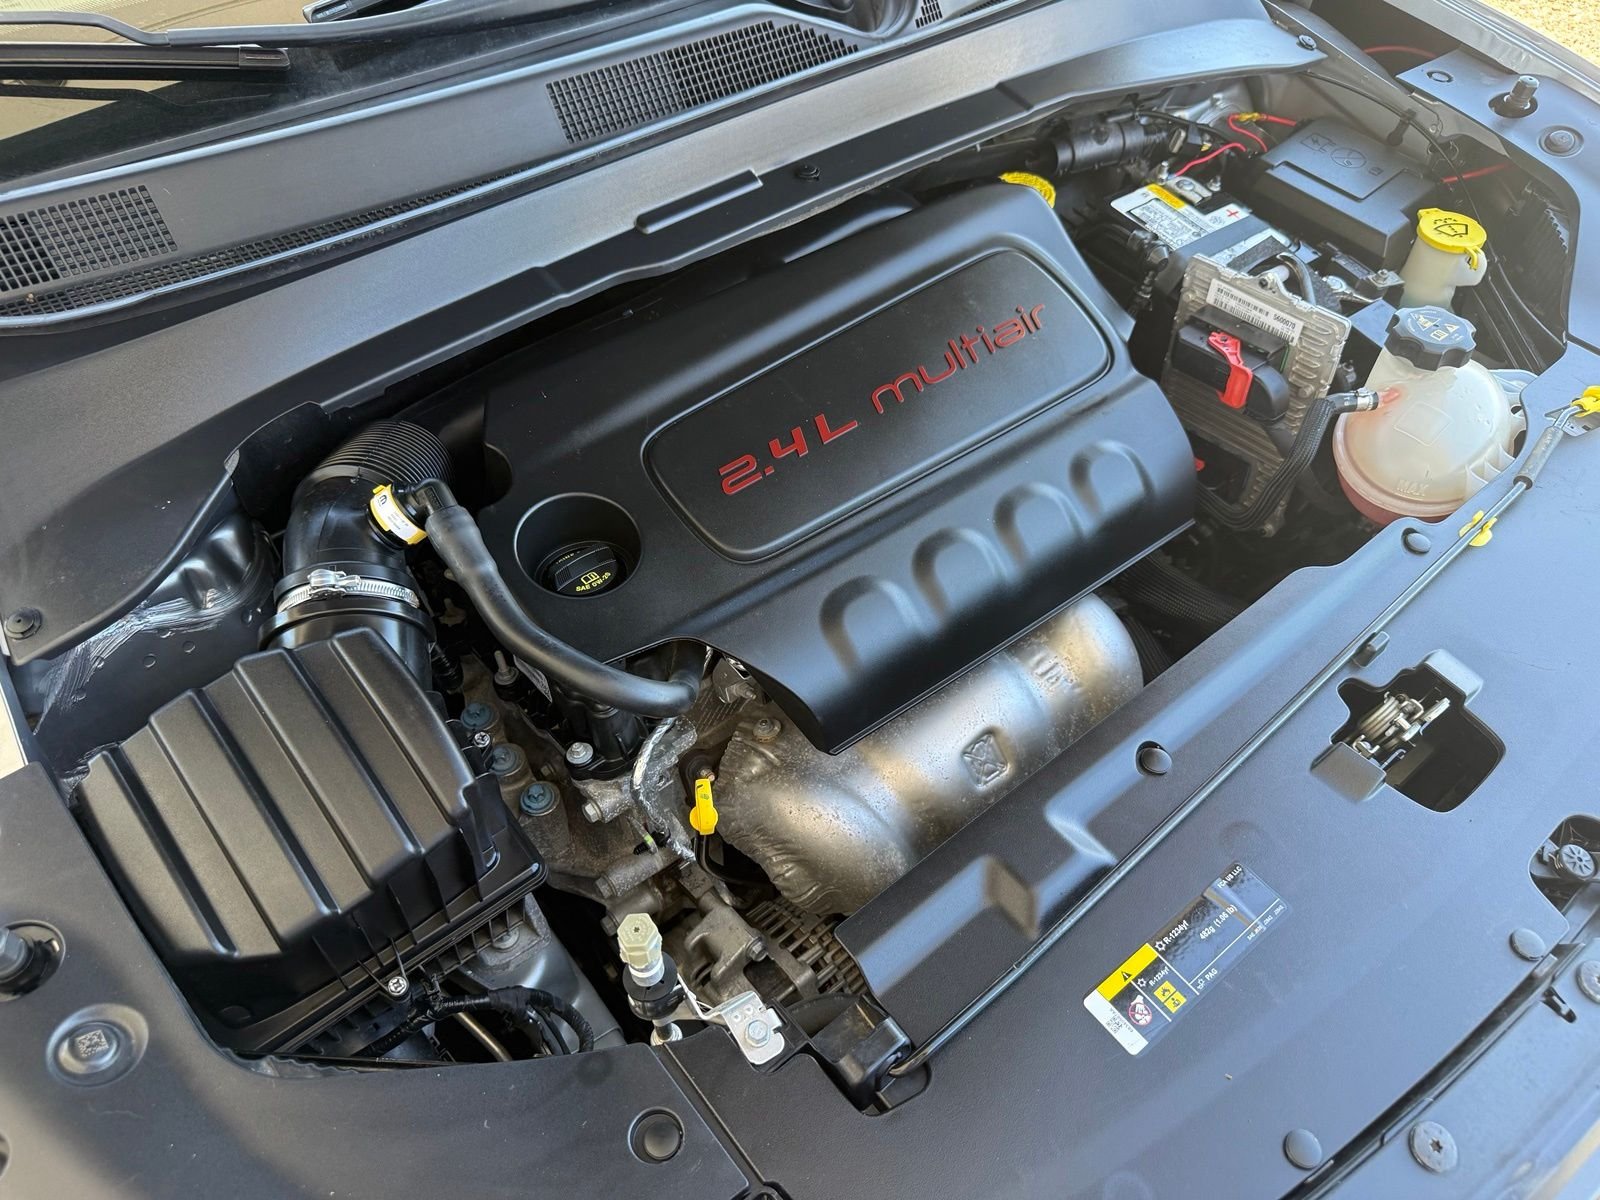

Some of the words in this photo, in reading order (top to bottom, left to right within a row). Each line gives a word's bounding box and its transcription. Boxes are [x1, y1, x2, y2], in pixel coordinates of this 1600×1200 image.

[871, 303, 1045, 414] multiair
[1163, 919, 1189, 944] R-1234yf
[1199, 926, 1216, 940] 482g
[1148, 966, 1170, 987] R-1234yf
[1205, 968, 1219, 981] PAG
